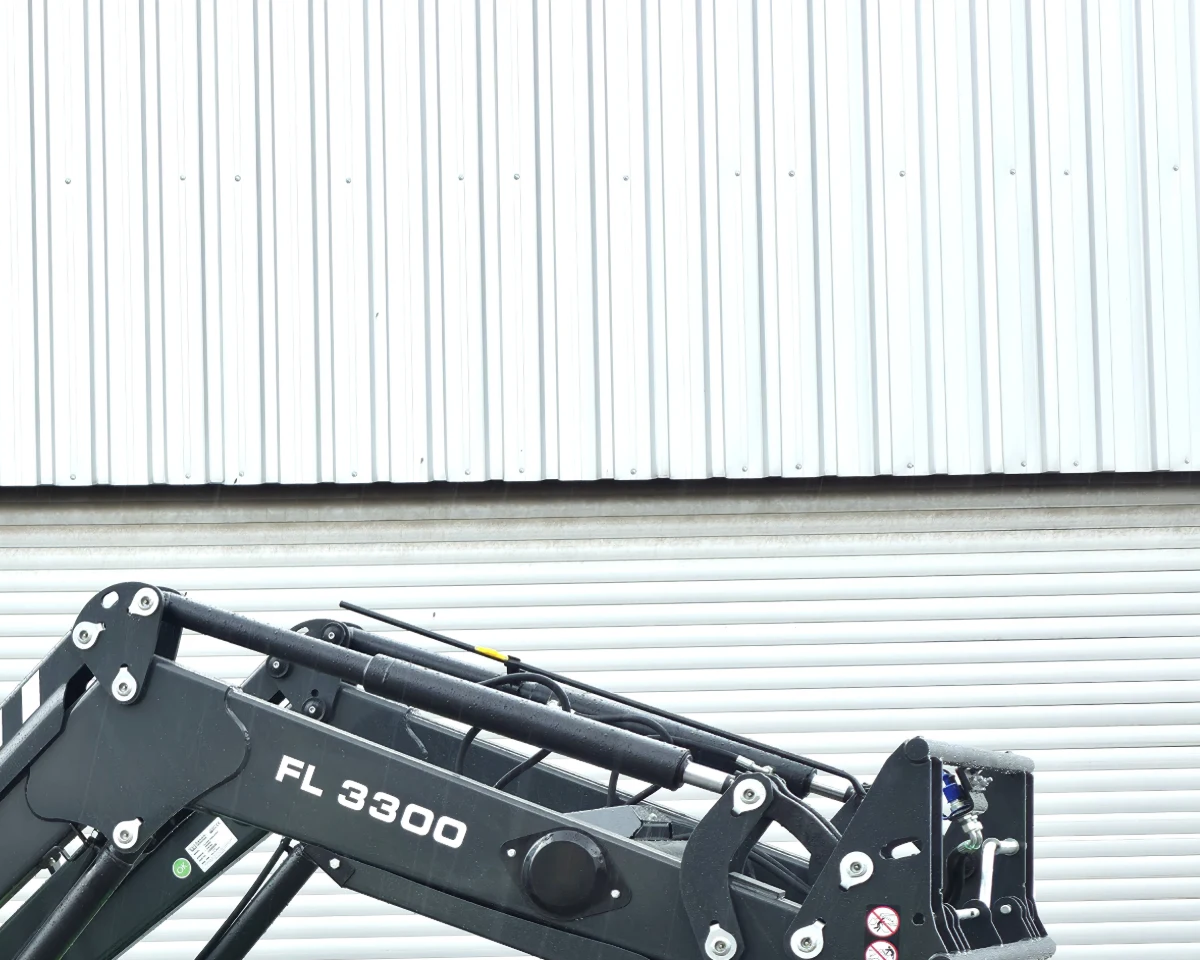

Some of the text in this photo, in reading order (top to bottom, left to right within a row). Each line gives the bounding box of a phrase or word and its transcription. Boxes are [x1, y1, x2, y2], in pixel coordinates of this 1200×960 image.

[275, 754, 468, 849] FL 3300
[176, 861, 188, 874] OK
